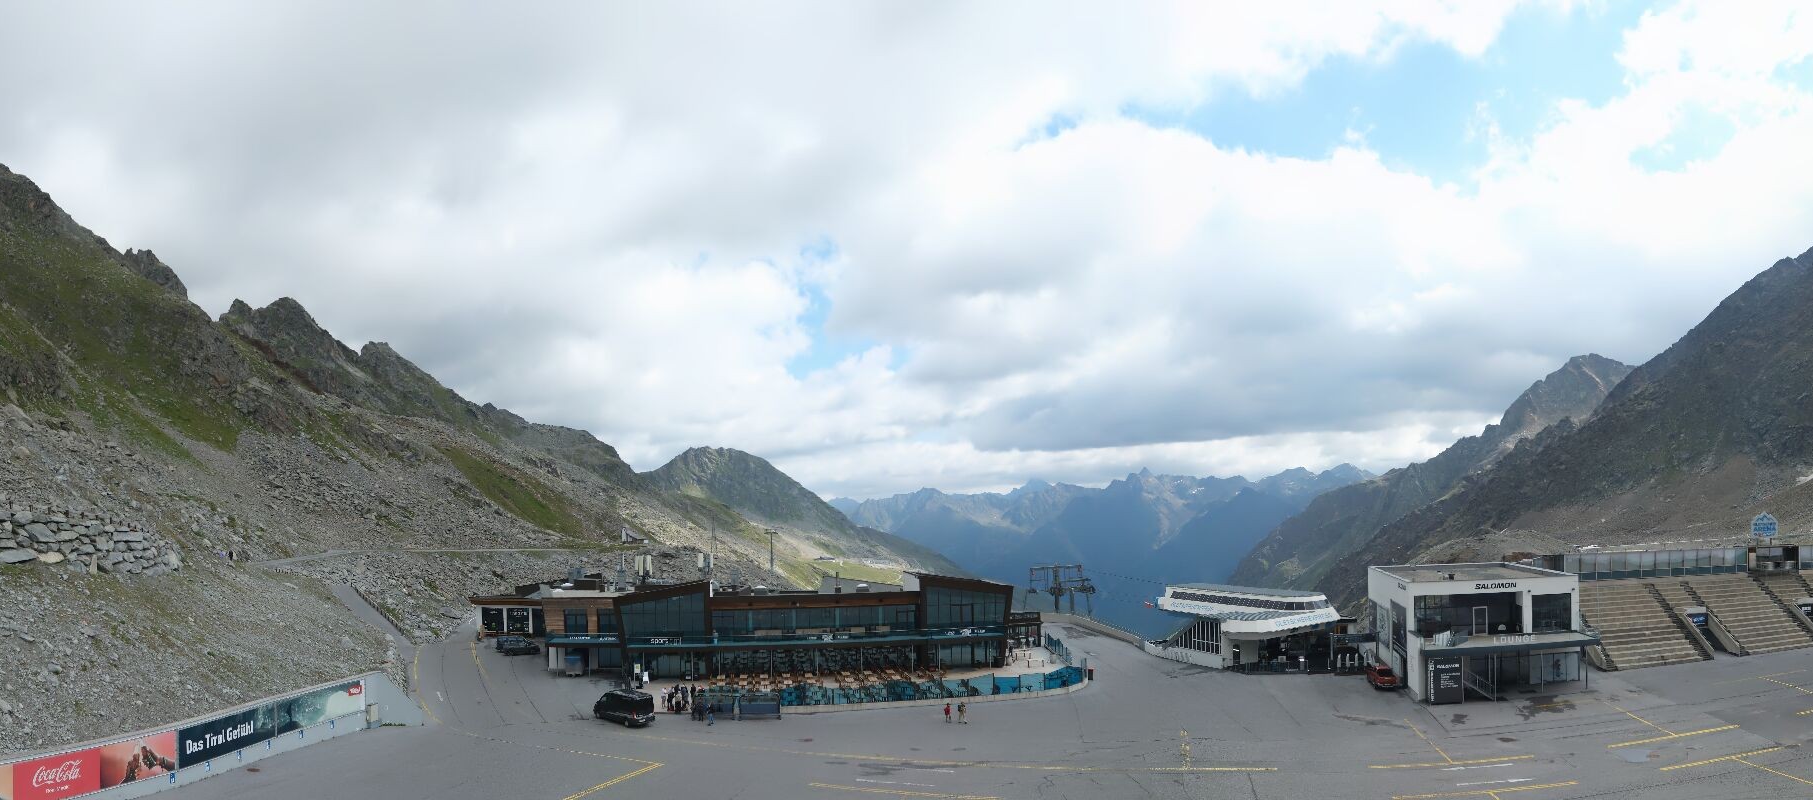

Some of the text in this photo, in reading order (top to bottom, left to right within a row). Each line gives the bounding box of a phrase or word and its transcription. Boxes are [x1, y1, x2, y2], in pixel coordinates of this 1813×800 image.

[1474, 582, 1517, 590] SALOMON
[1493, 634, 1536, 645] LOUNGE
[186, 720, 254, 755] Das Tirol Gefühl
[32, 759, 83, 787] Coca-Cola
